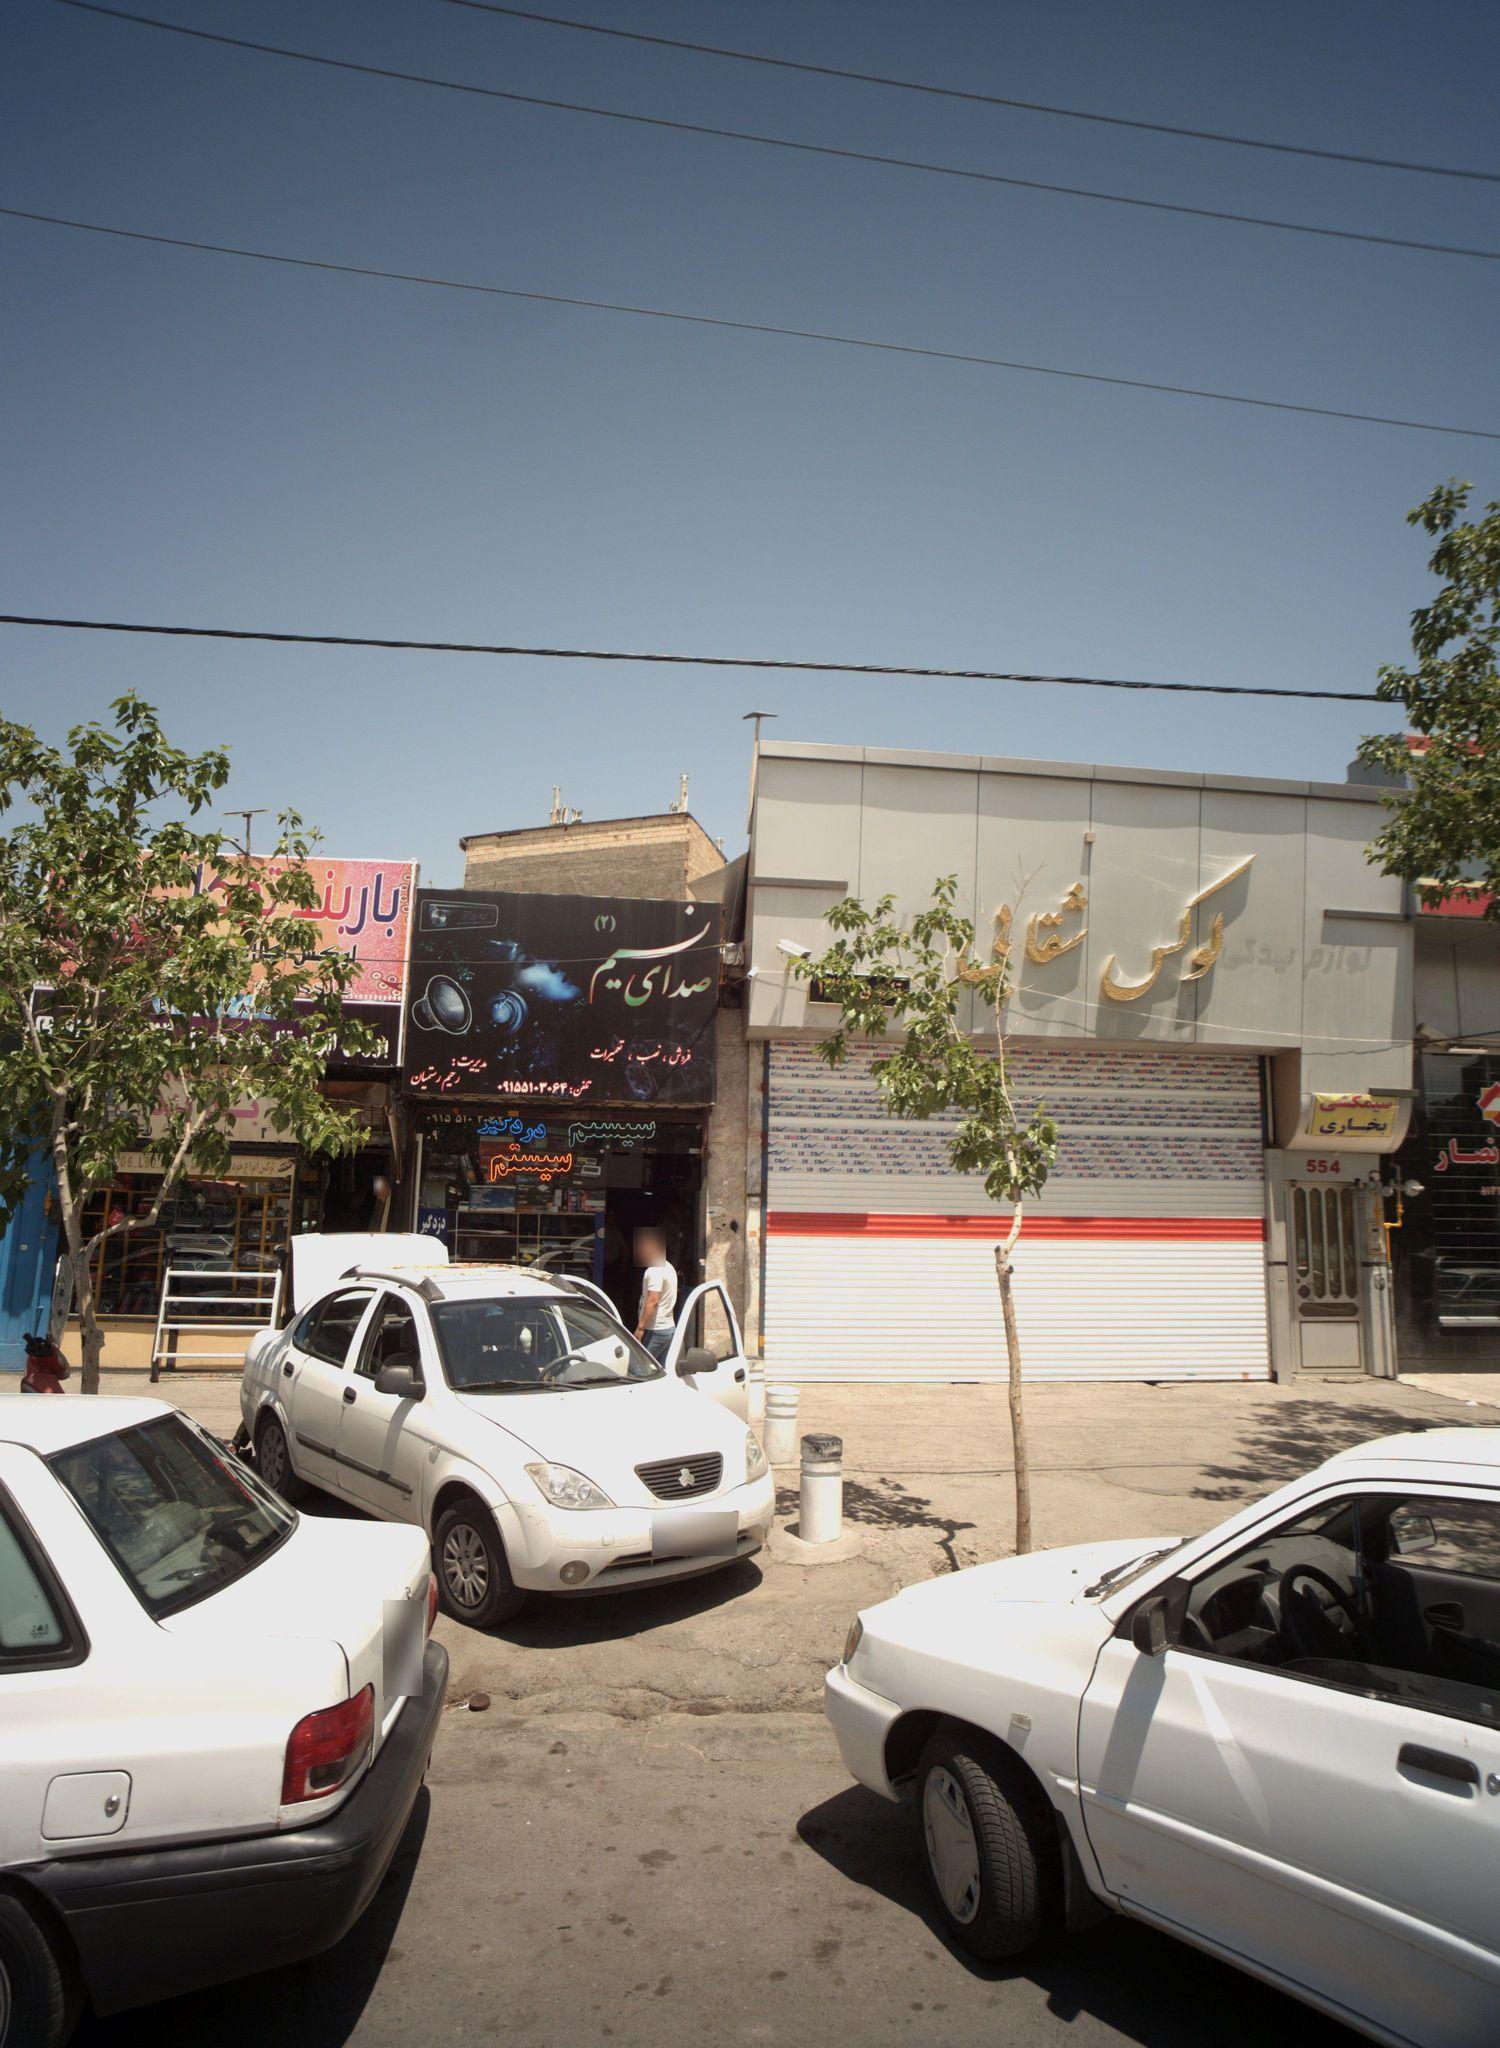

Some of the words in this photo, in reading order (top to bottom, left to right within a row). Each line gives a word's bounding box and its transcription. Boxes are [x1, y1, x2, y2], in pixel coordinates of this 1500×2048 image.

[589, 904, 711, 1004] نسیم
[624, 964, 712, 1006] صدای
[1319, 1117, 1388, 1135] بخاری
[490, 1143, 573, 1183] سیستم
[1306, 1160, 1341, 1174] 554
[420, 1214, 446, 1235] دزدگیر
